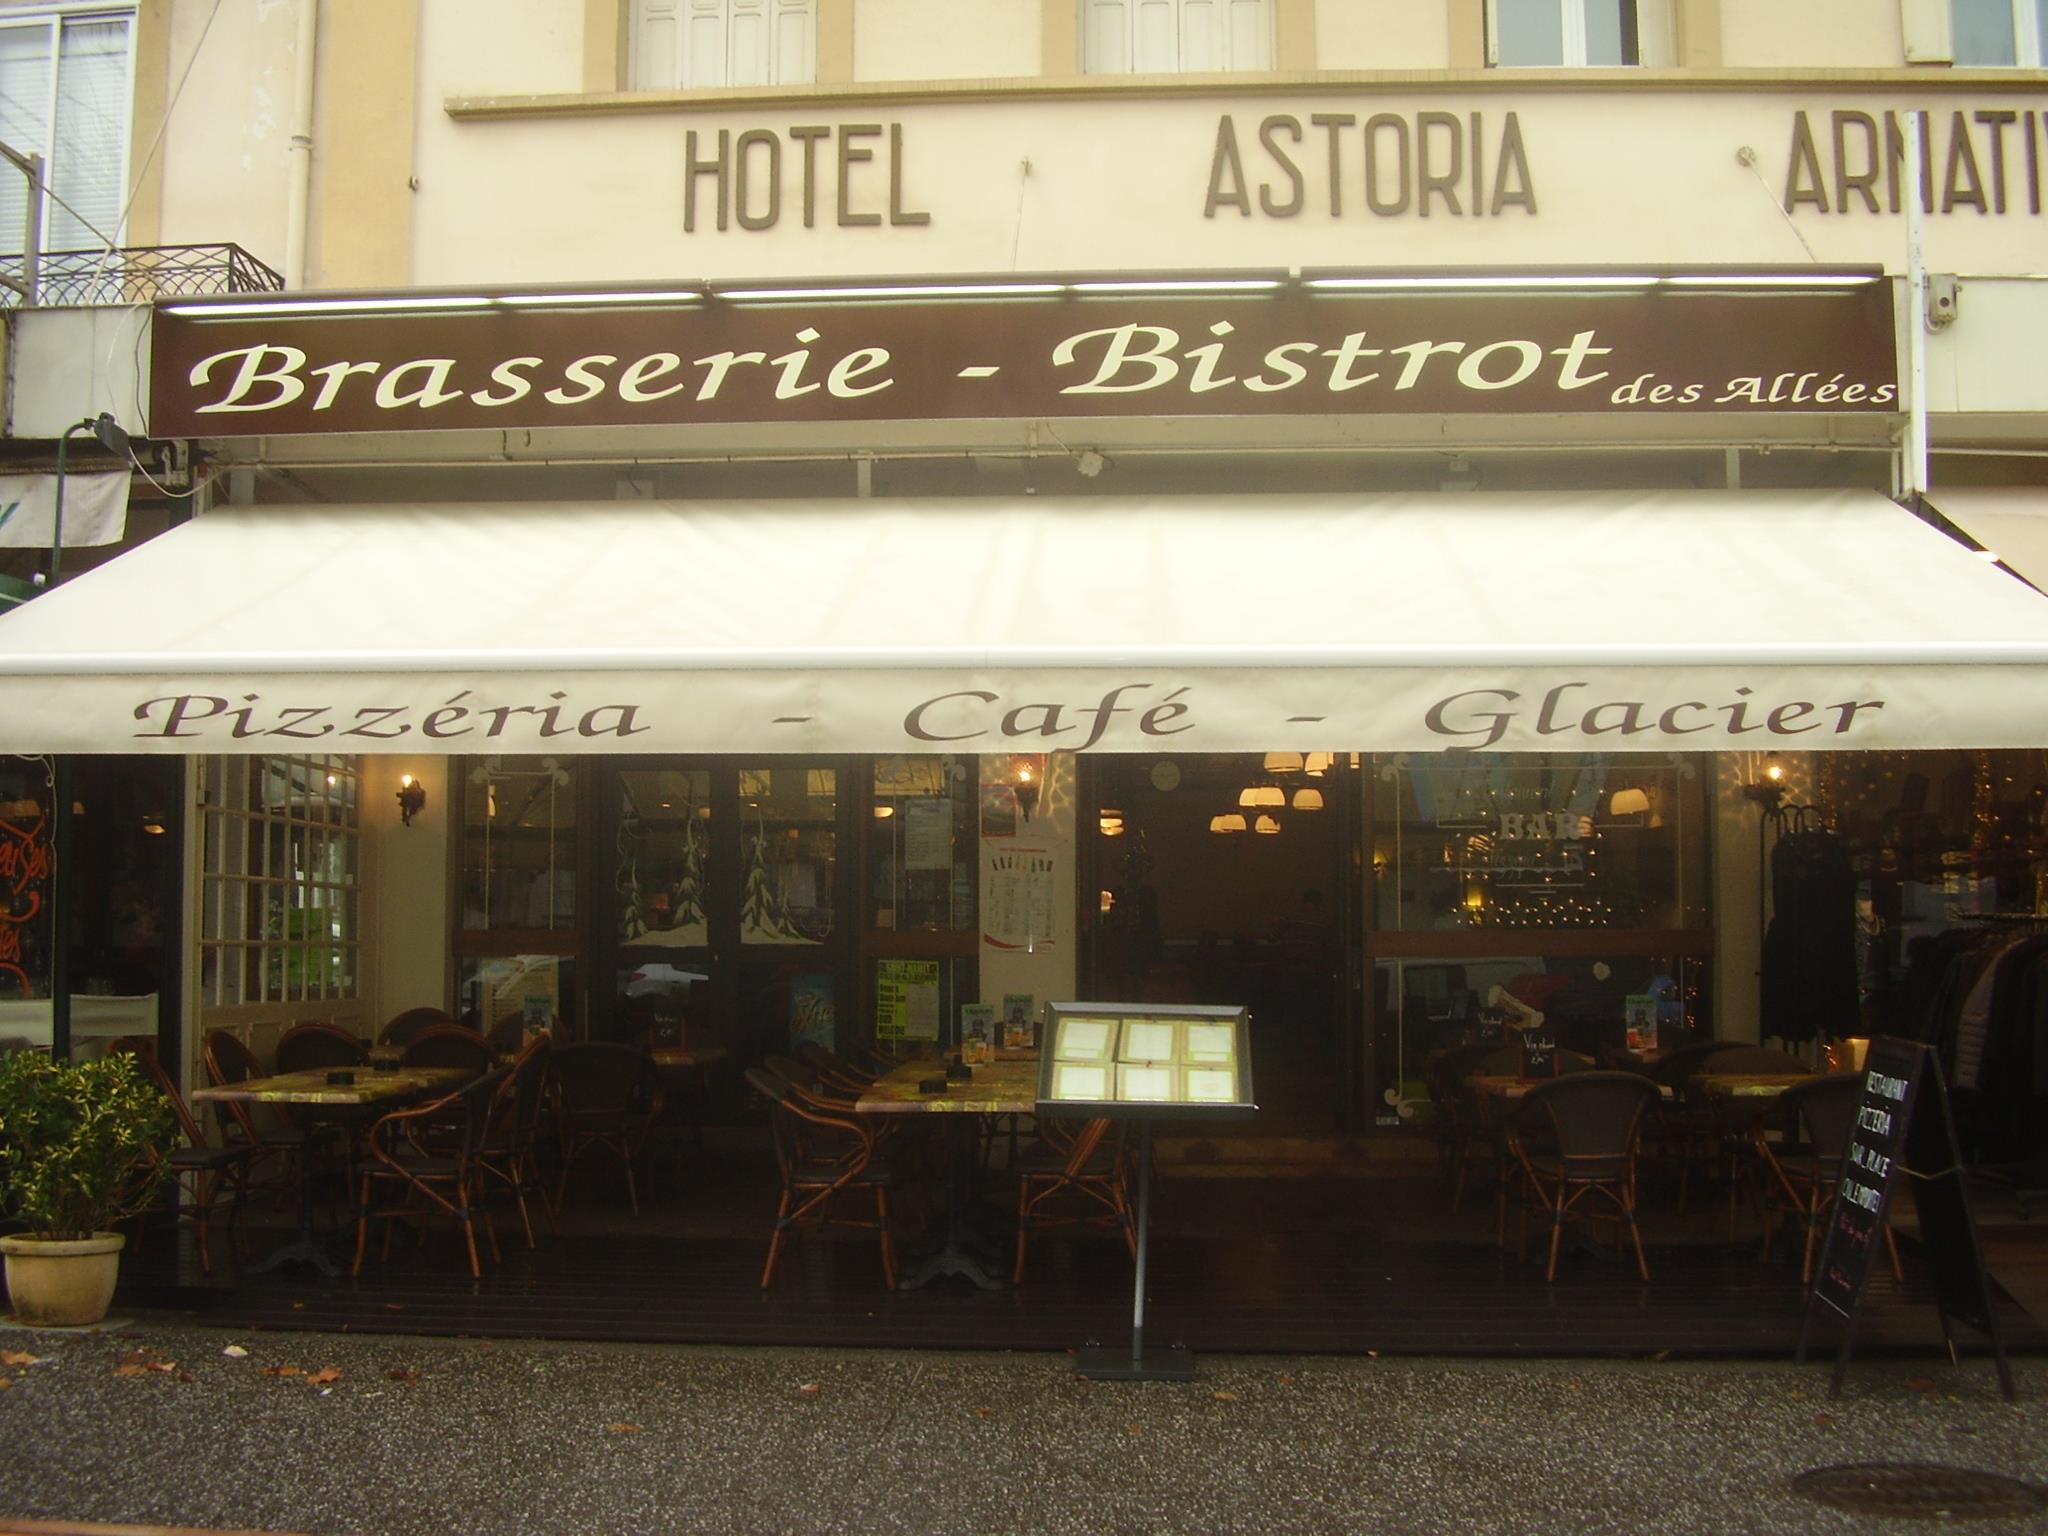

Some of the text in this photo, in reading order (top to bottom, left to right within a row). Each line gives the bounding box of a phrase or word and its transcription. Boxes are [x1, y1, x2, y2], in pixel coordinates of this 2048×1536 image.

[684, 110, 2048, 233] HOTEL ASTORIA ARNATI
[189, 320, 1896, 413] Brasserie - Bistrot des Allées
[132, 682, 1886, 753] Pizzéria - Café - Glacier
[1499, 813, 1581, 840] BAR
